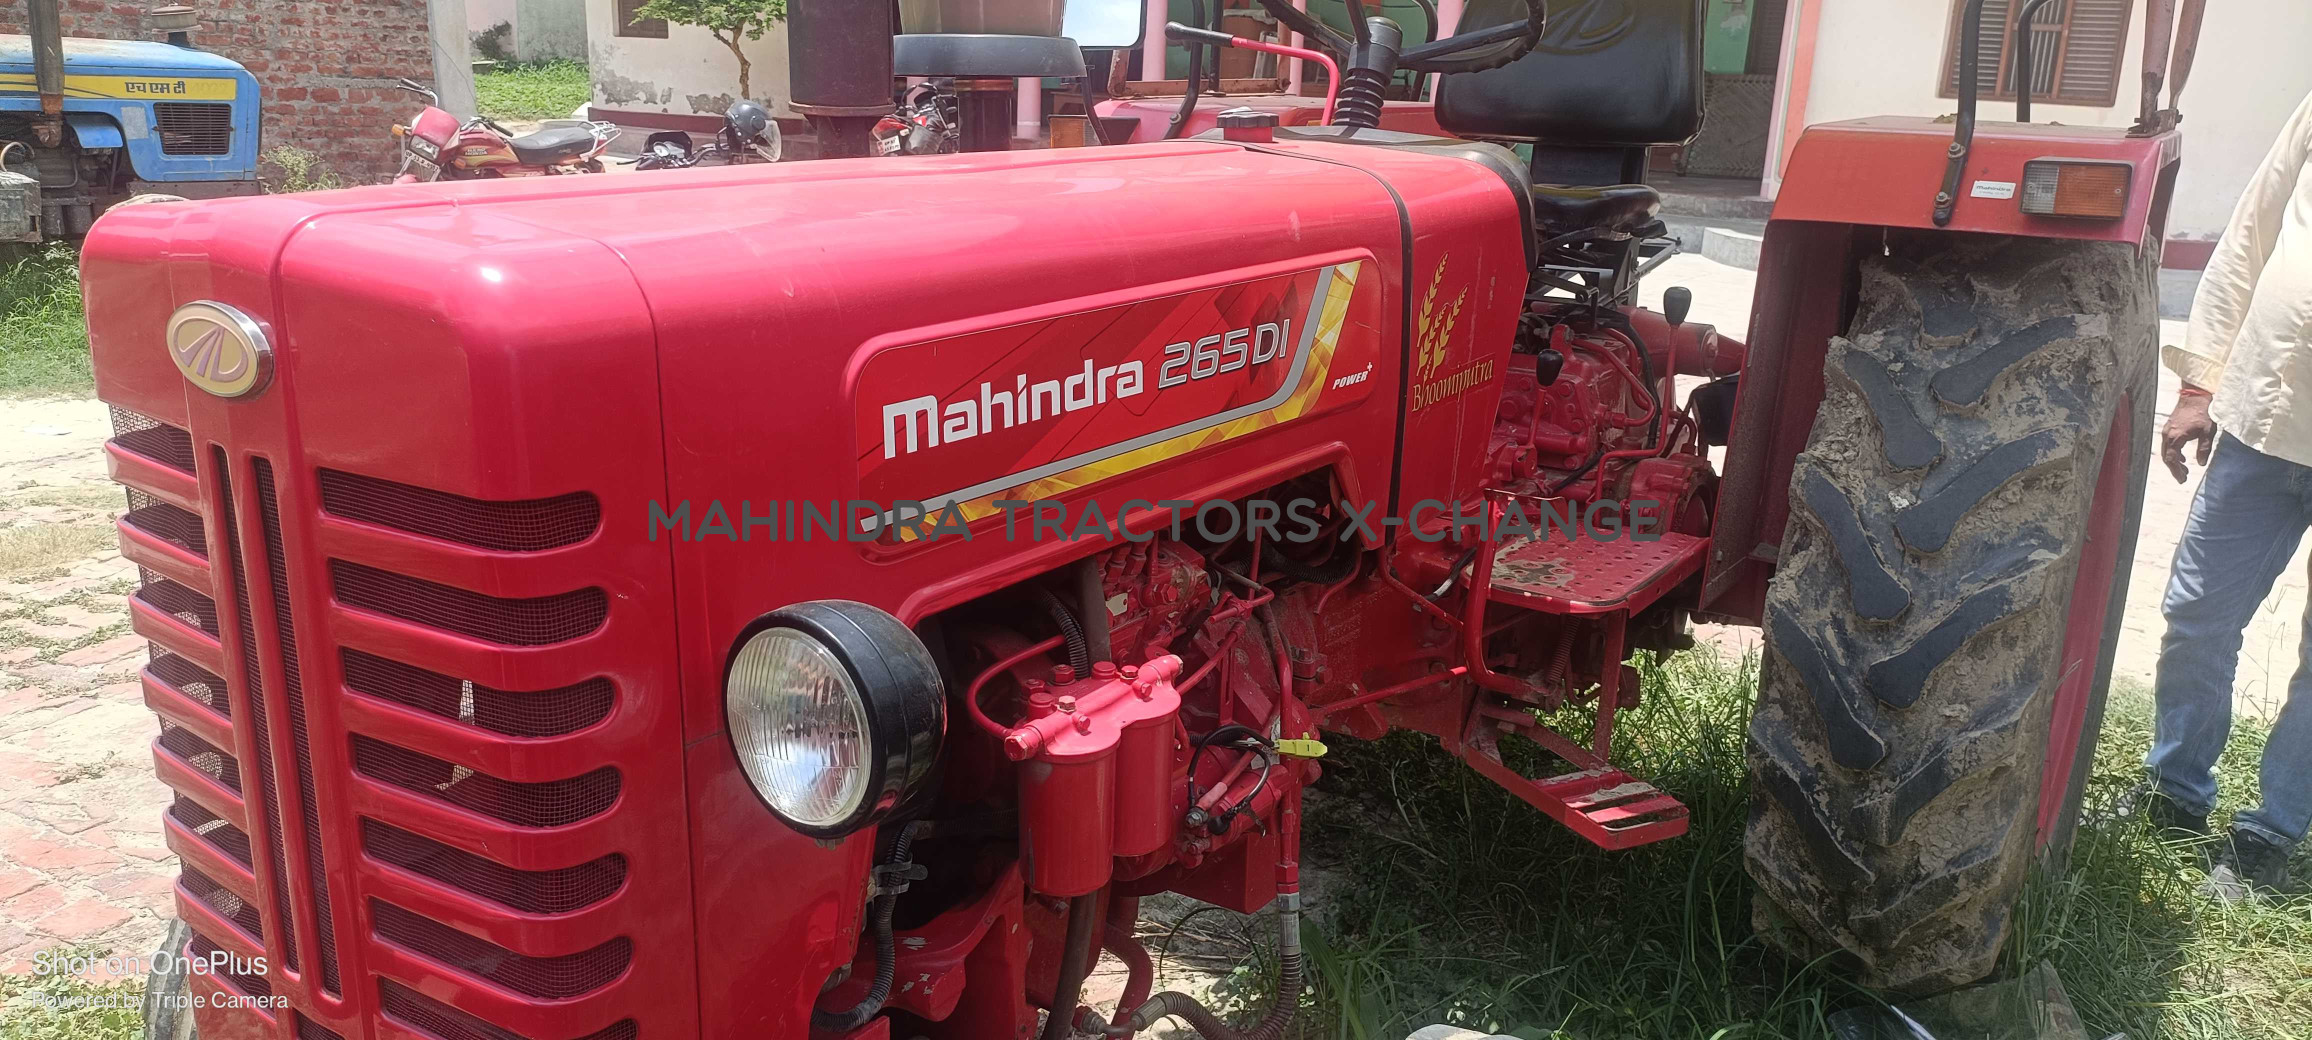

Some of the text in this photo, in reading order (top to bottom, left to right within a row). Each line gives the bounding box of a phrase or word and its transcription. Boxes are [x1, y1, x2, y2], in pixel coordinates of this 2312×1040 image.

[125, 82, 147, 93] एच
[173, 81, 187, 94] टी
[883, 358, 1144, 460] Mahindra
[1412, 359, 1494, 412] Bhoomiputra
